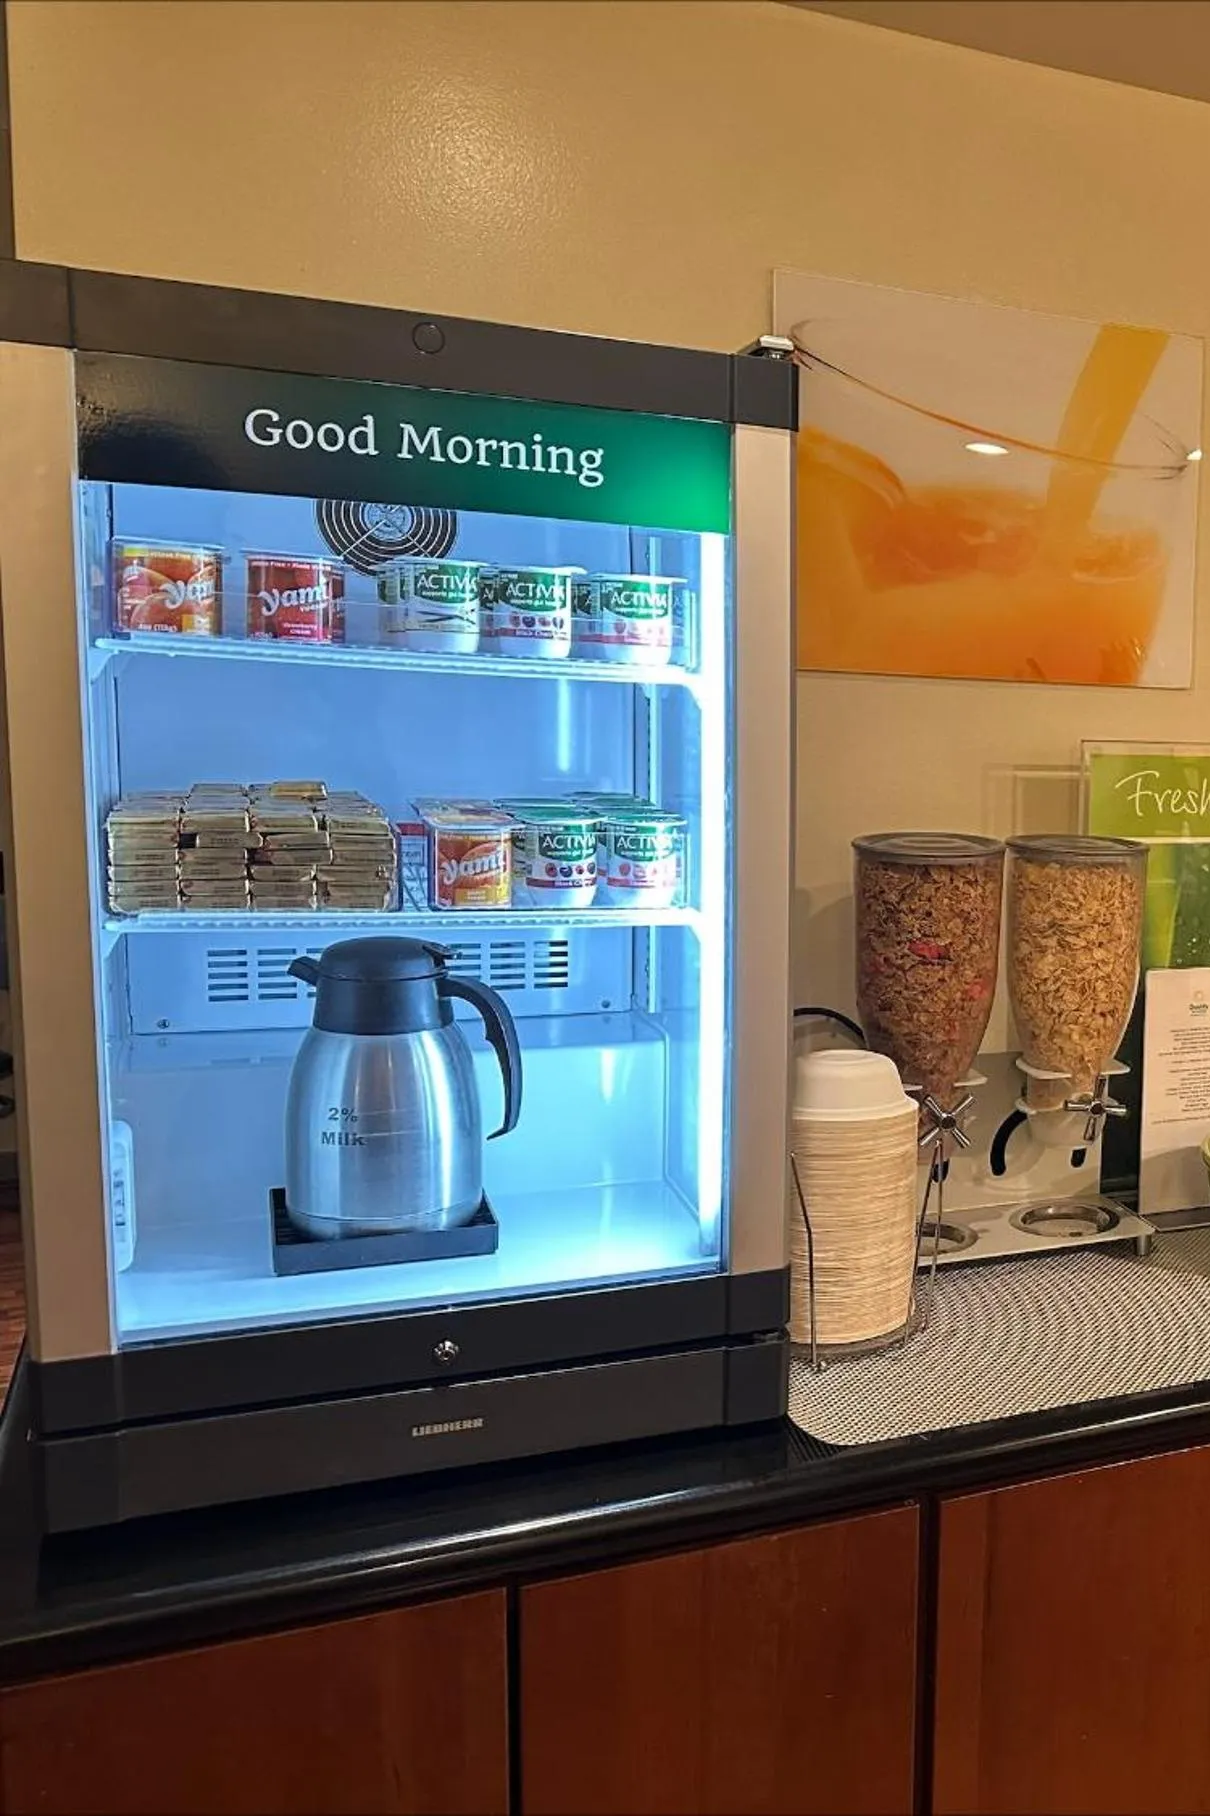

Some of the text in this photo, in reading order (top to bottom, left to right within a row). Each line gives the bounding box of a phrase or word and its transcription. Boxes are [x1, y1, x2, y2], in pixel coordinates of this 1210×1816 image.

[244, 408, 605, 488] Good Morning
[327, 1106, 360, 1123] 2%
[320, 1130, 368, 1146] Milk
